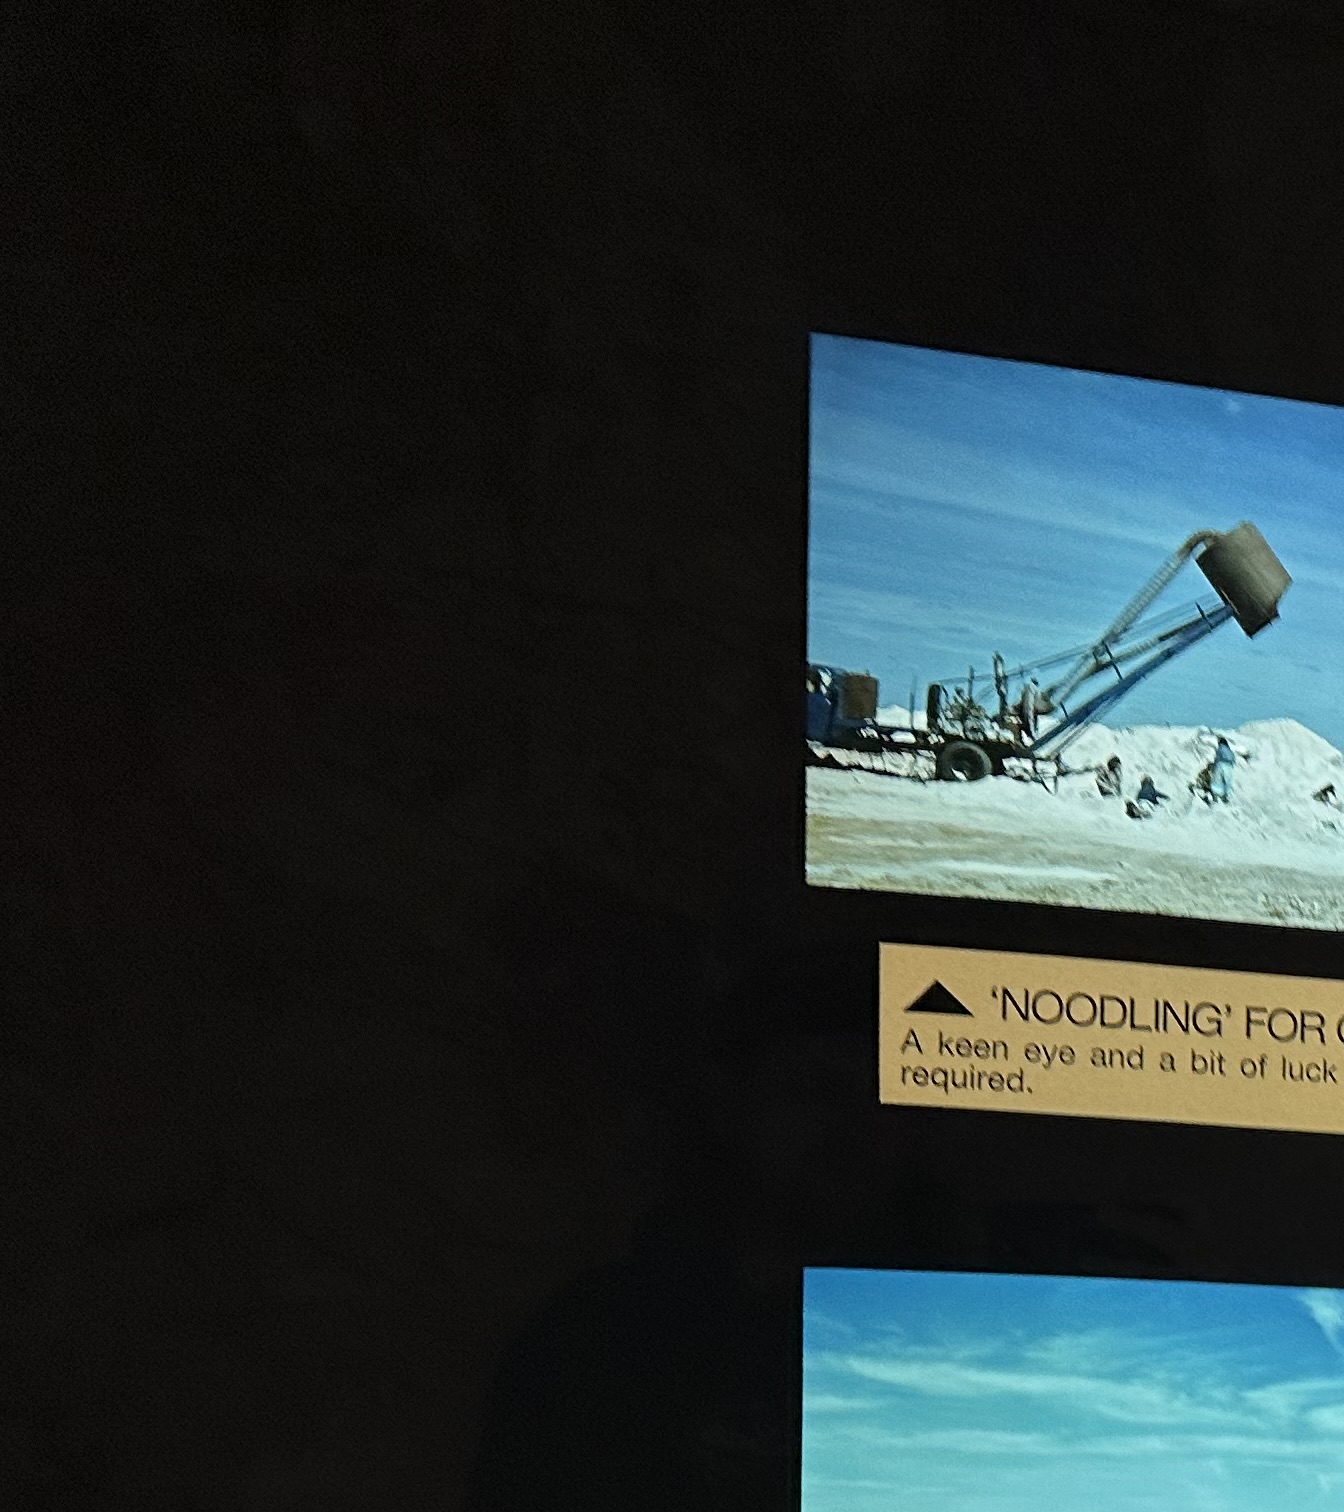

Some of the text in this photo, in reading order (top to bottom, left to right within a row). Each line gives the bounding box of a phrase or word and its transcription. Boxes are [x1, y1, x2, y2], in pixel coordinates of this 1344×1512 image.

[991, 987, 1232, 1038] 'NOODLING'
[1245, 1006, 1326, 1046] FOR
[900, 1029, 923, 1055] A
[938, 1032, 1009, 1061] keen
[1024, 1043, 1076, 1071] eye
[1090, 1045, 1144, 1071] and
[1159, 1053, 1175, 1073] a
[1190, 1049, 1226, 1076] bit
[1240, 1054, 1266, 1079] of
[1281, 1055, 1337, 1084] luck
[901, 1068, 1033, 1095] required.
